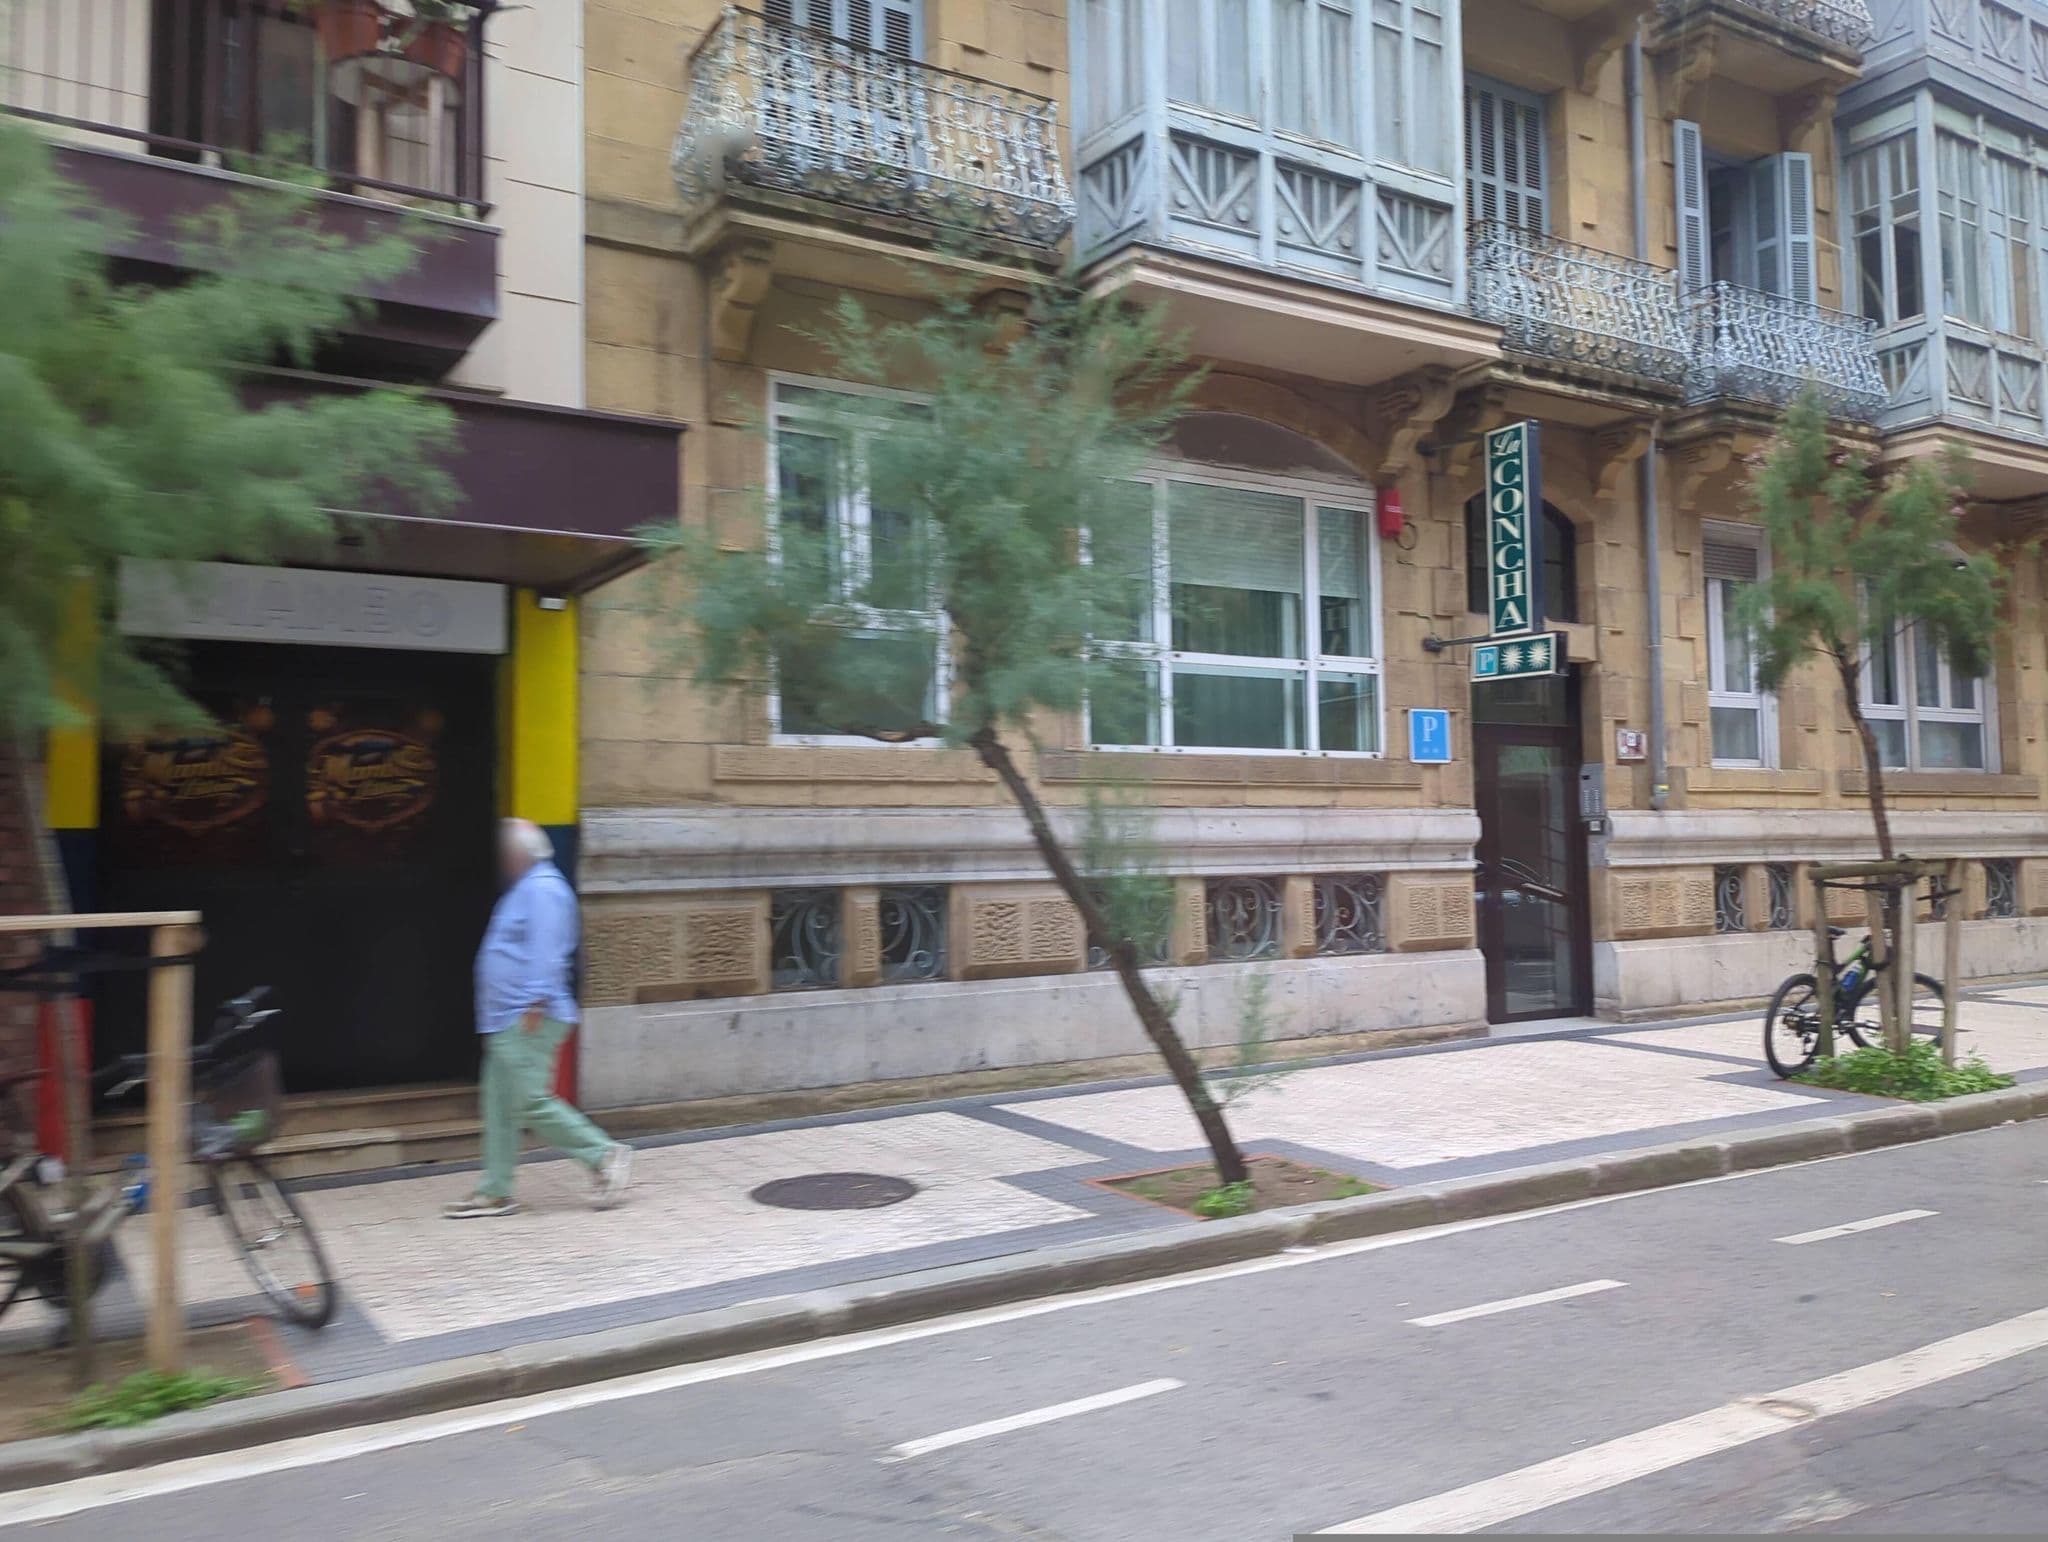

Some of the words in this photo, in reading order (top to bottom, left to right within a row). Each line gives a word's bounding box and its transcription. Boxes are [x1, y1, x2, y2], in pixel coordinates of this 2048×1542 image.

[1493, 430, 1522, 457] La
[1493, 459, 1528, 628] CONCHA
[1479, 651, 1494, 672] P
[1421, 715, 1438, 742] P
